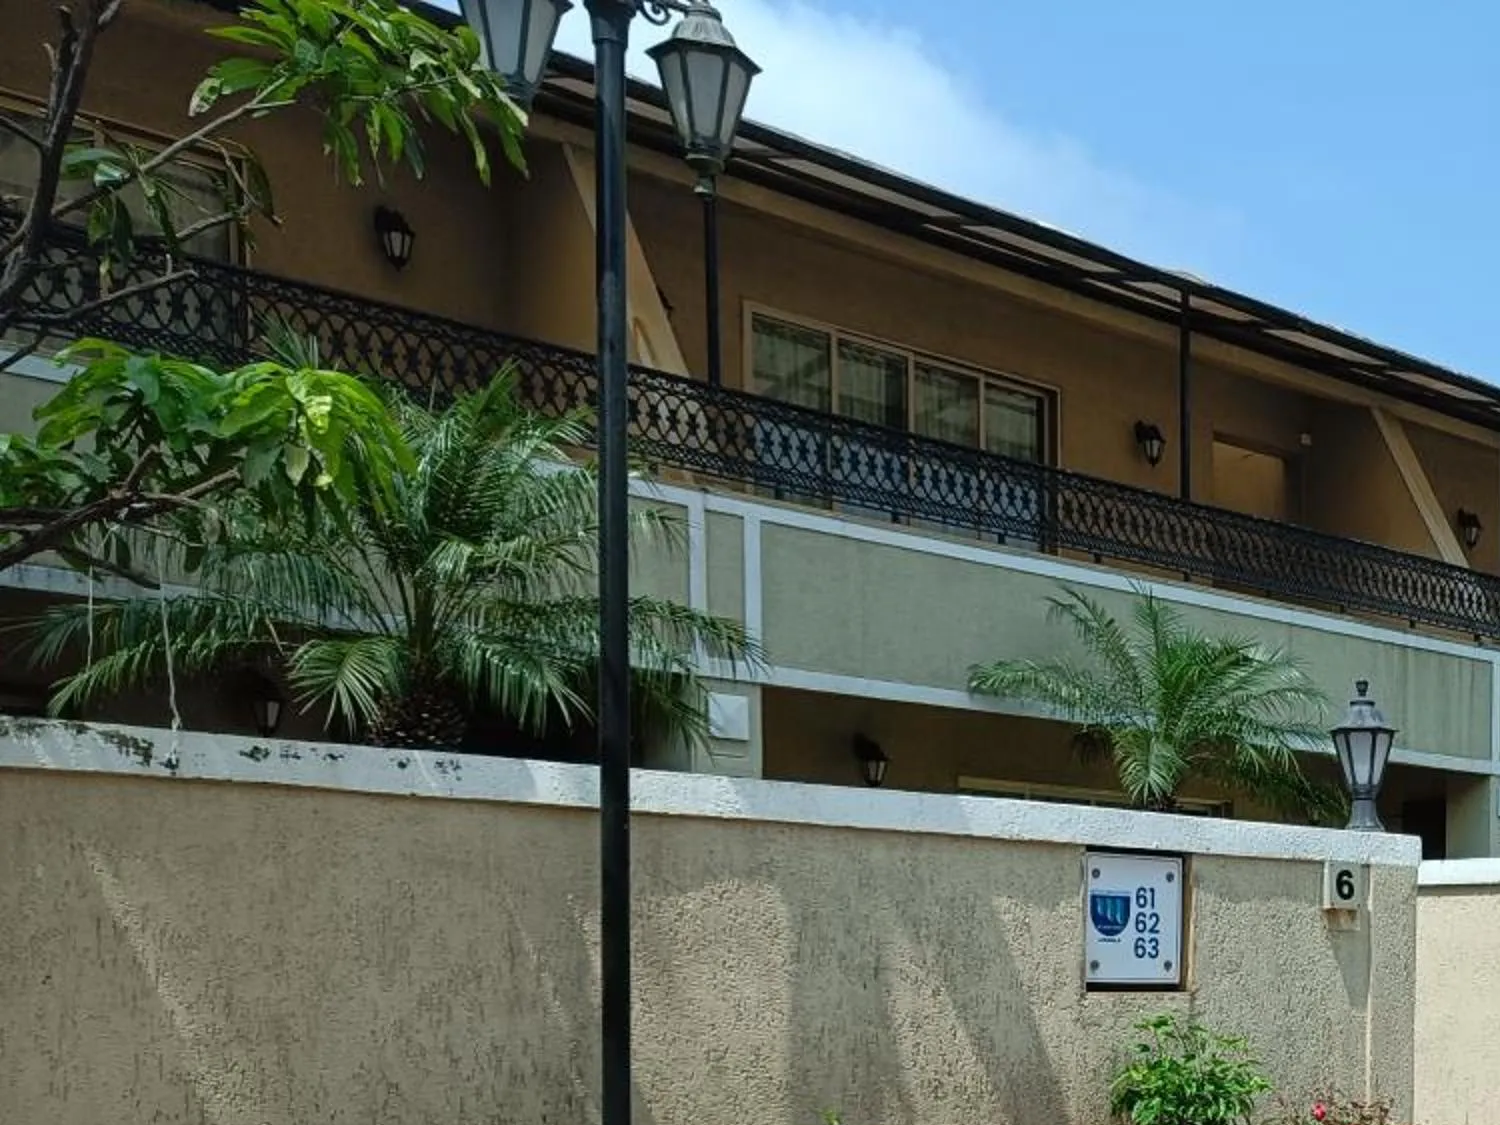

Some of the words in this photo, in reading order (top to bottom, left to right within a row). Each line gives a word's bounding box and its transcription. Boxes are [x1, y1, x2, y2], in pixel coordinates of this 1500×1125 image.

[1336, 869, 1354, 900] 6
[1135, 887, 1155, 909] 61
[1135, 912, 1160, 934] 62
[1134, 937, 1159, 959] 63
